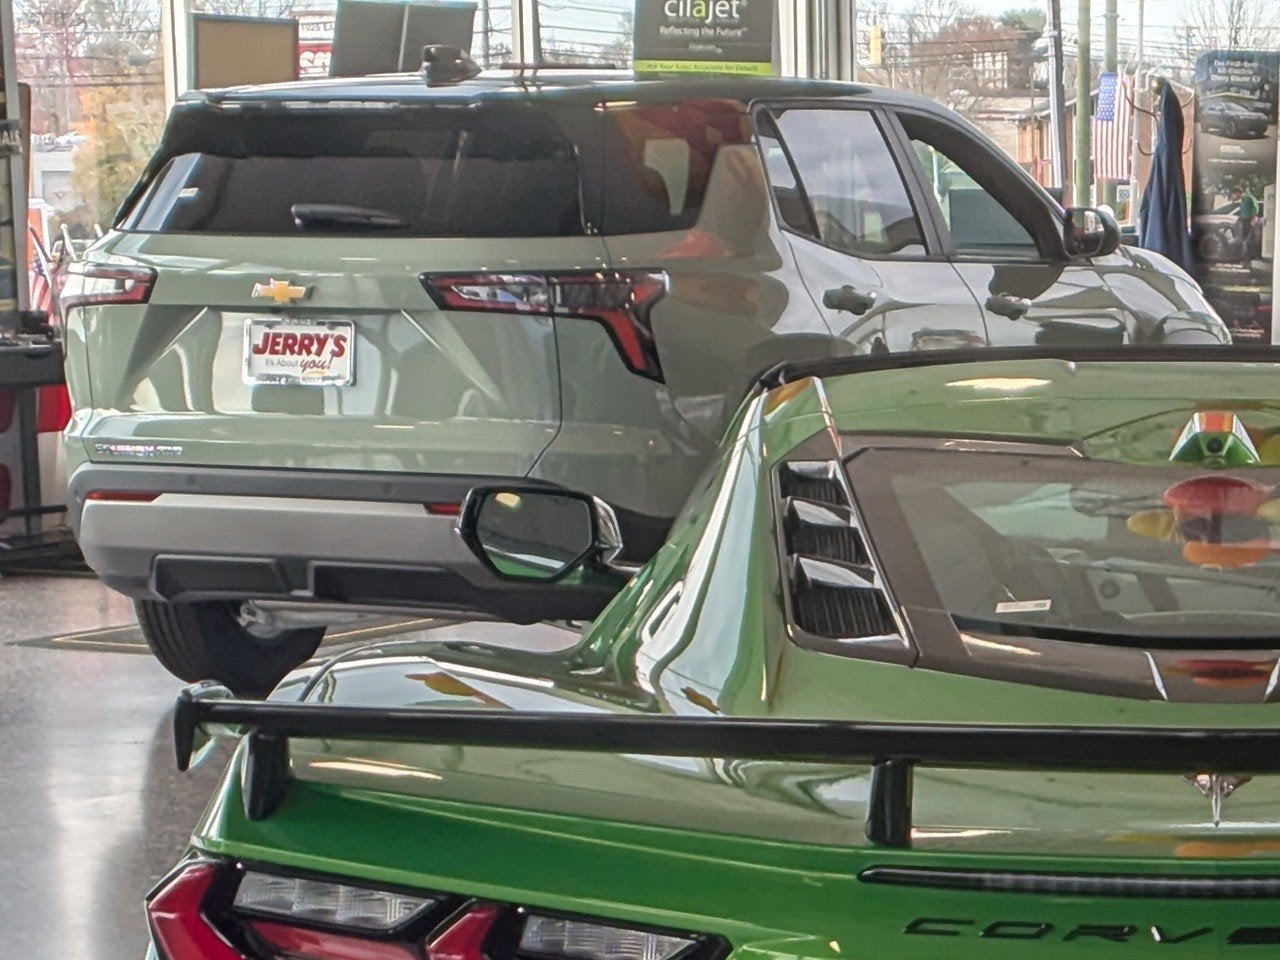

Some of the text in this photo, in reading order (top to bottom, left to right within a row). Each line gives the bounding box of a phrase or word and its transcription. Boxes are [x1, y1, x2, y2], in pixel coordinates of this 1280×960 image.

[660, 26, 699, 37] Reflecting
[702, 26, 714, 35] the
[252, 331, 348, 358] JERRY'S
[277, 359, 299, 367] About
[300, 356, 333, 373] you!
